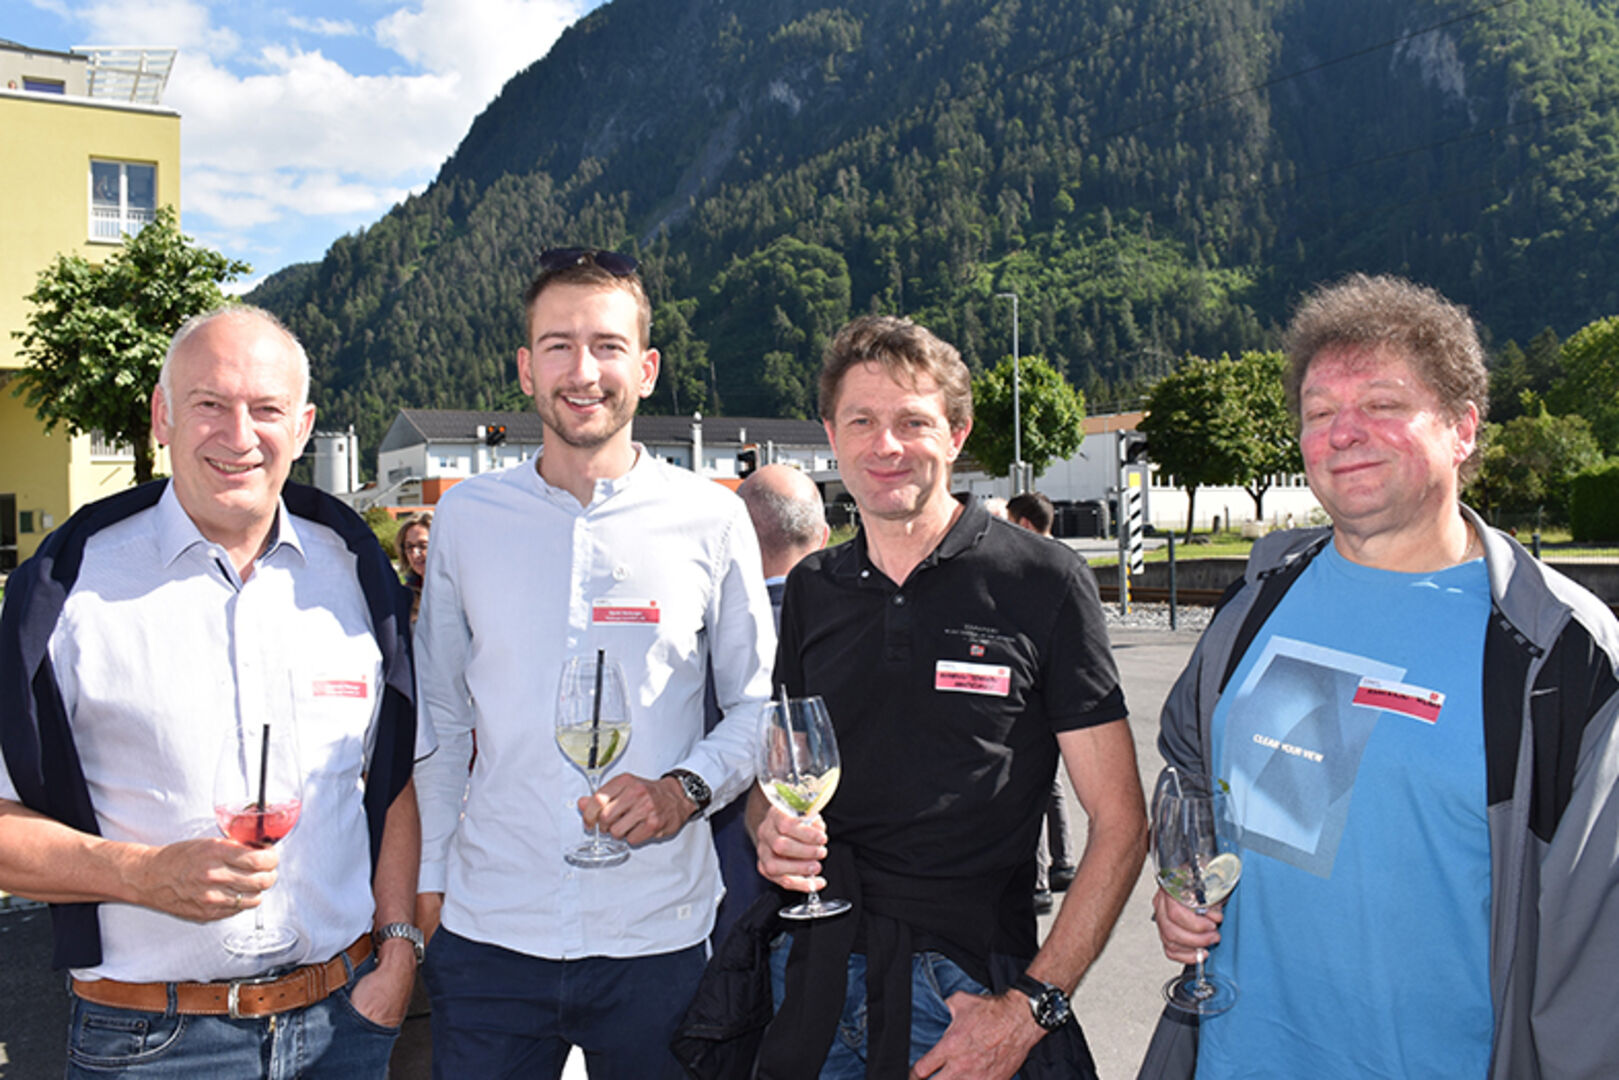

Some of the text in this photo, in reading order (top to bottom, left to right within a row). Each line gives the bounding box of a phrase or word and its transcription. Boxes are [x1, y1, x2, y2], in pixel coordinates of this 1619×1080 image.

[1253, 734, 1324, 762] CLEAR YOUR VIEW
